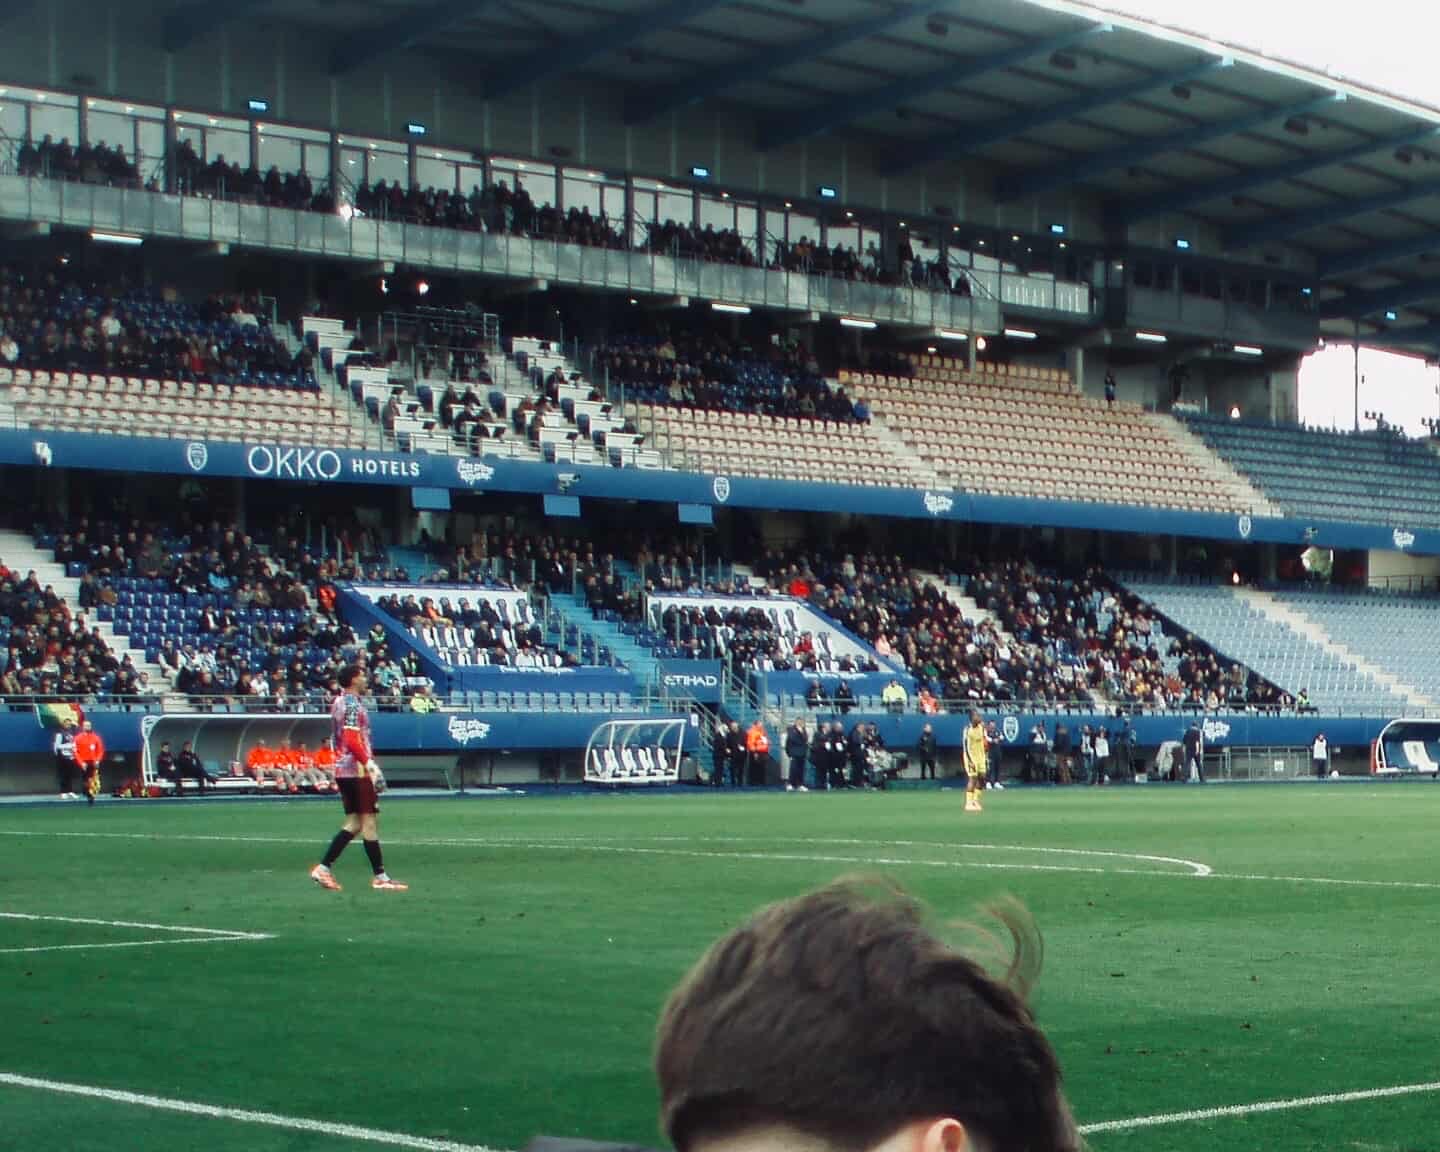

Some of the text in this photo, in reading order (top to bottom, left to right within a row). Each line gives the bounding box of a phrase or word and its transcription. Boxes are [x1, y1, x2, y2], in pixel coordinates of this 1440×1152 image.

[248, 446, 421, 479] OKKO HOTELS
[664, 674, 718, 687] ETIHAD
